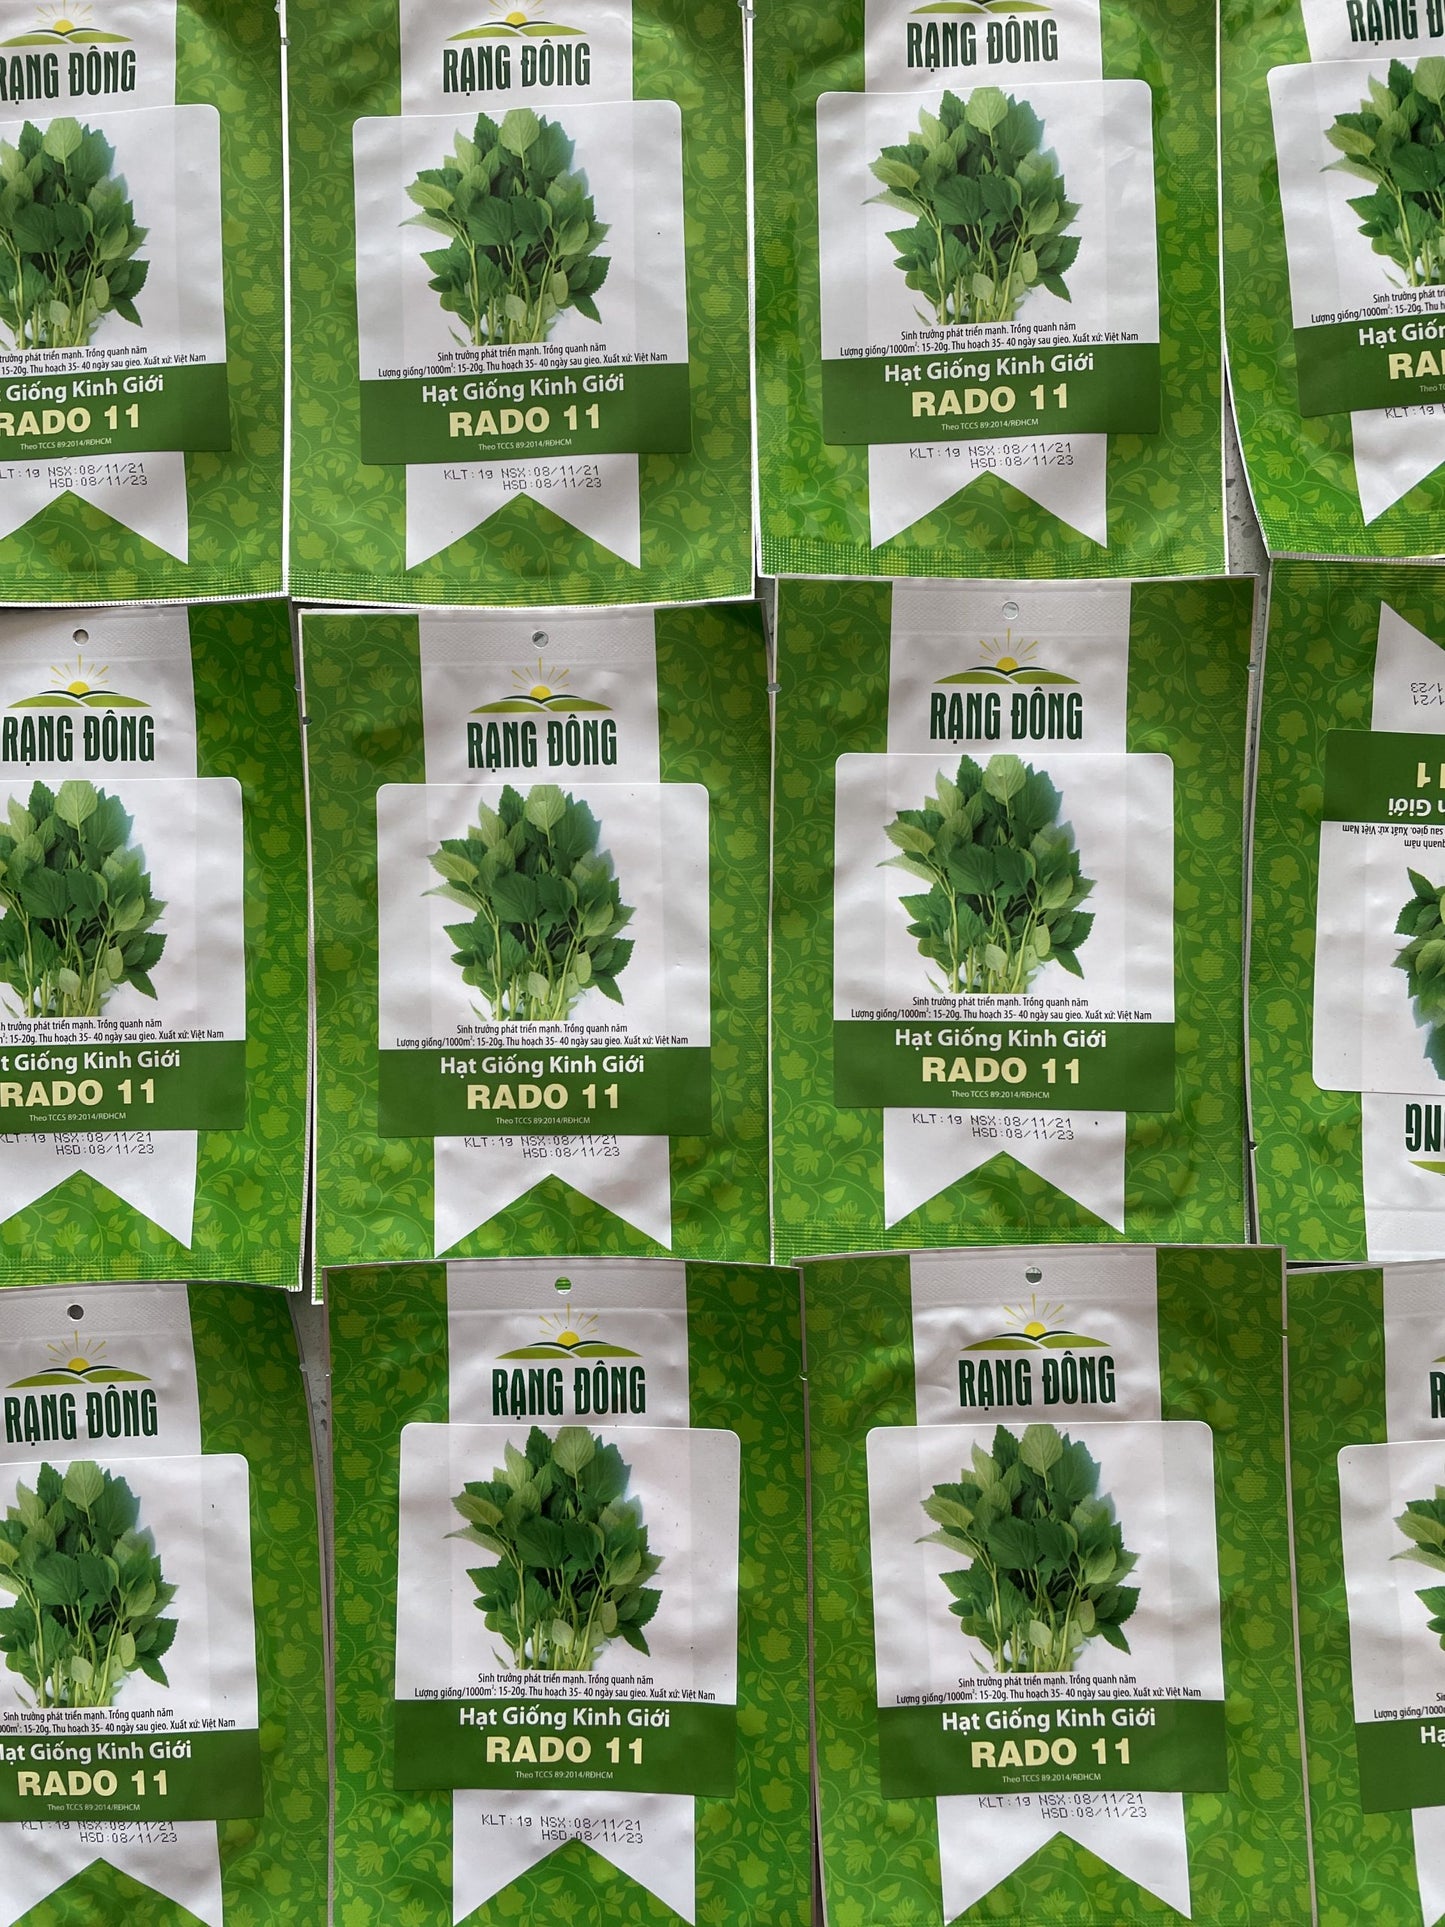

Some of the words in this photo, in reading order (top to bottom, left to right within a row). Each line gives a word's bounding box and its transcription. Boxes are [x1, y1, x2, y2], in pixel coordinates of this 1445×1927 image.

[907, 21, 977, 73] RẠNG
[986, 15, 1058, 64] ĐÔNG
[68, 45, 136, 97] ĐÔNG
[443, 45, 511, 96] RẠNG
[520, 38, 590, 88] ĐÔNG
[1359, 328, 1397, 348] Hạt
[885, 364, 922, 386] Hạt
[926, 358, 990, 382] Giống
[997, 355, 1045, 376] Kinh
[1050, 352, 1094, 372] Giới
[6, 380, 67, 402] Giống
[72, 377, 118, 398] Kinh
[123, 374, 163, 394] Giới
[422, 385, 458, 407] Hạt
[463, 378, 524, 402] Giống
[530, 376, 577, 396] Kinh
[582, 373, 624, 393] Giới
[912, 386, 1016, 417] RADO
[1030, 383, 1067, 410] 11
[0, 407, 91, 437] RADO
[104, 403, 139, 430] 11
[449, 406, 550, 438] RADO
[563, 403, 599, 430] 11
[968, 442, 1074, 459] NSX:08/11/21
[970, 454, 1077, 469] HSD:08/11/23
[47, 462, 145, 478] NSX:08/11/21
[49, 474, 148, 488] HSD:08/11/23
[500, 464, 600, 480] NSX:08/11/21
[502, 477, 604, 490] HSD:08/11/23
[930, 692, 1001, 745] RẠNG
[1010, 686, 1083, 740] ĐÔNG
[2, 715, 73, 767] RẠNG
[83, 709, 155, 762] ĐÔNG
[467, 720, 538, 773] RẠNG
[546, 713, 617, 767] ĐÔNG
[1388, 798, 1431, 817] Giới
[896, 1028, 932, 1051] Hạt
[938, 1027, 1002, 1052] Giống
[1008, 1029, 1057, 1047] Kinh
[1063, 1029, 1106, 1048] Giới
[14, 1052, 77, 1073] Giống
[84, 1050, 132, 1069] Kinh
[137, 1049, 180, 1068] Giới
[441, 1057, 477, 1079] Hạt
[482, 1054, 544, 1078] Giống
[550, 1055, 597, 1073] Kinh
[602, 1054, 644, 1073] Giới
[922, 1056, 1027, 1084] RADO
[1042, 1058, 1079, 1084] 11
[0, 1079, 103, 1108] RADO
[117, 1078, 154, 1104] 11
[467, 1083, 568, 1110] RADO
[582, 1083, 618, 1109] 11
[970, 1115, 1071, 1129] NSX:08/11/21
[972, 1126, 1074, 1141] HSD:08/11/23
[1406, 1104, 1445, 1152] NG
[54, 1132, 152, 1143] NSX:08/11/21
[55, 1144, 154, 1156] HSD:08/11/23
[521, 1134, 618, 1147] NSX:08/11/21
[522, 1146, 620, 1159] HSD:08/11/23
[492, 1367, 564, 1421] RẠNG
[573, 1360, 646, 1415] ĐÔNG
[958, 1358, 1032, 1412] RẠNG
[1041, 1350, 1116, 1405] ĐÔNG
[4, 1392, 78, 1447] RẠNG
[85, 1386, 158, 1439] ĐÔNG
[460, 1707, 498, 1730] Hạt
[502, 1706, 567, 1730] Giống
[573, 1707, 621, 1726] Kinh
[627, 1708, 670, 1727] Giới
[942, 1712, 981, 1736] Hạt
[985, 1709, 1050, 1733] Giống
[1056, 1708, 1106, 1727] Kinh
[1112, 1707, 1156, 1726] Giới
[1420, 1726, 1445, 1748] Hạ
[30, 1741, 92, 1764] Giống
[97, 1741, 144, 1760] Kinh
[149, 1740, 191, 1759] Giới
[486, 1736, 592, 1763] RADO
[606, 1737, 642, 1764] 11
[971, 1738, 1077, 1768] RADO
[1091, 1738, 1130, 1765] 11
[17, 1770, 118, 1796] RADO
[131, 1770, 167, 1796] 11
[1038, 1792, 1143, 1808] NSX:08/11/21
[1041, 1806, 1147, 1819] HSD:08/11/23
[540, 1816, 640, 1831] NSX:08/11/21
[79, 1832, 178, 1844] HSD:08/11/23
[541, 1829, 643, 1845] HSD:08/11/23
